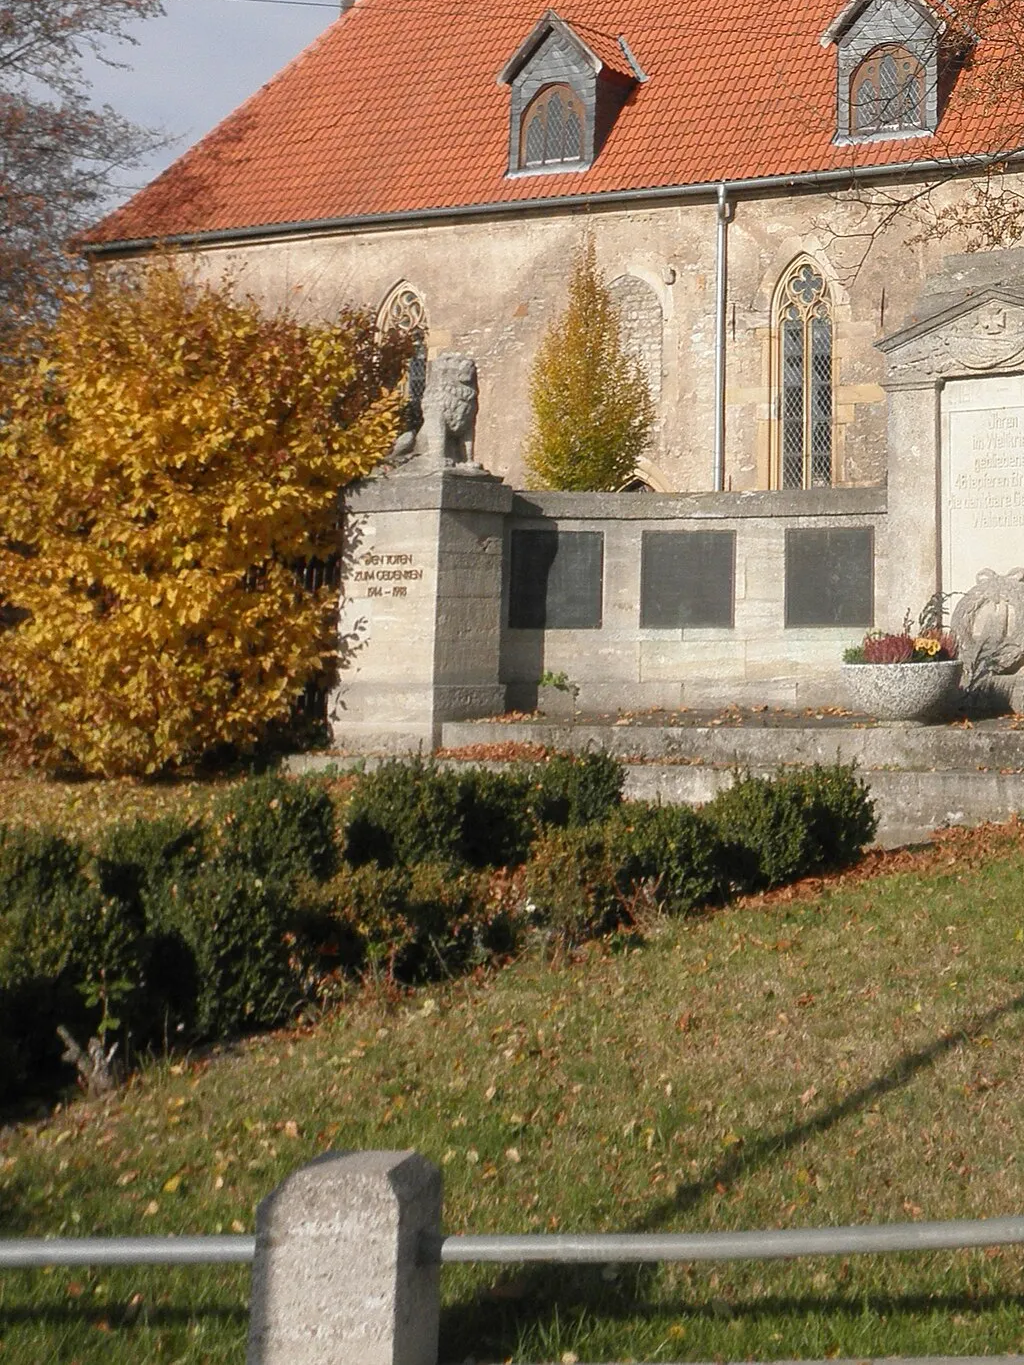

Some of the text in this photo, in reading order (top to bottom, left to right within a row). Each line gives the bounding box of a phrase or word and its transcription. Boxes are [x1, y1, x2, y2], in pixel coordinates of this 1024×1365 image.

[386, 554, 413, 565] TOTEN
[354, 569, 424, 582] ZUM GEDENKEN
